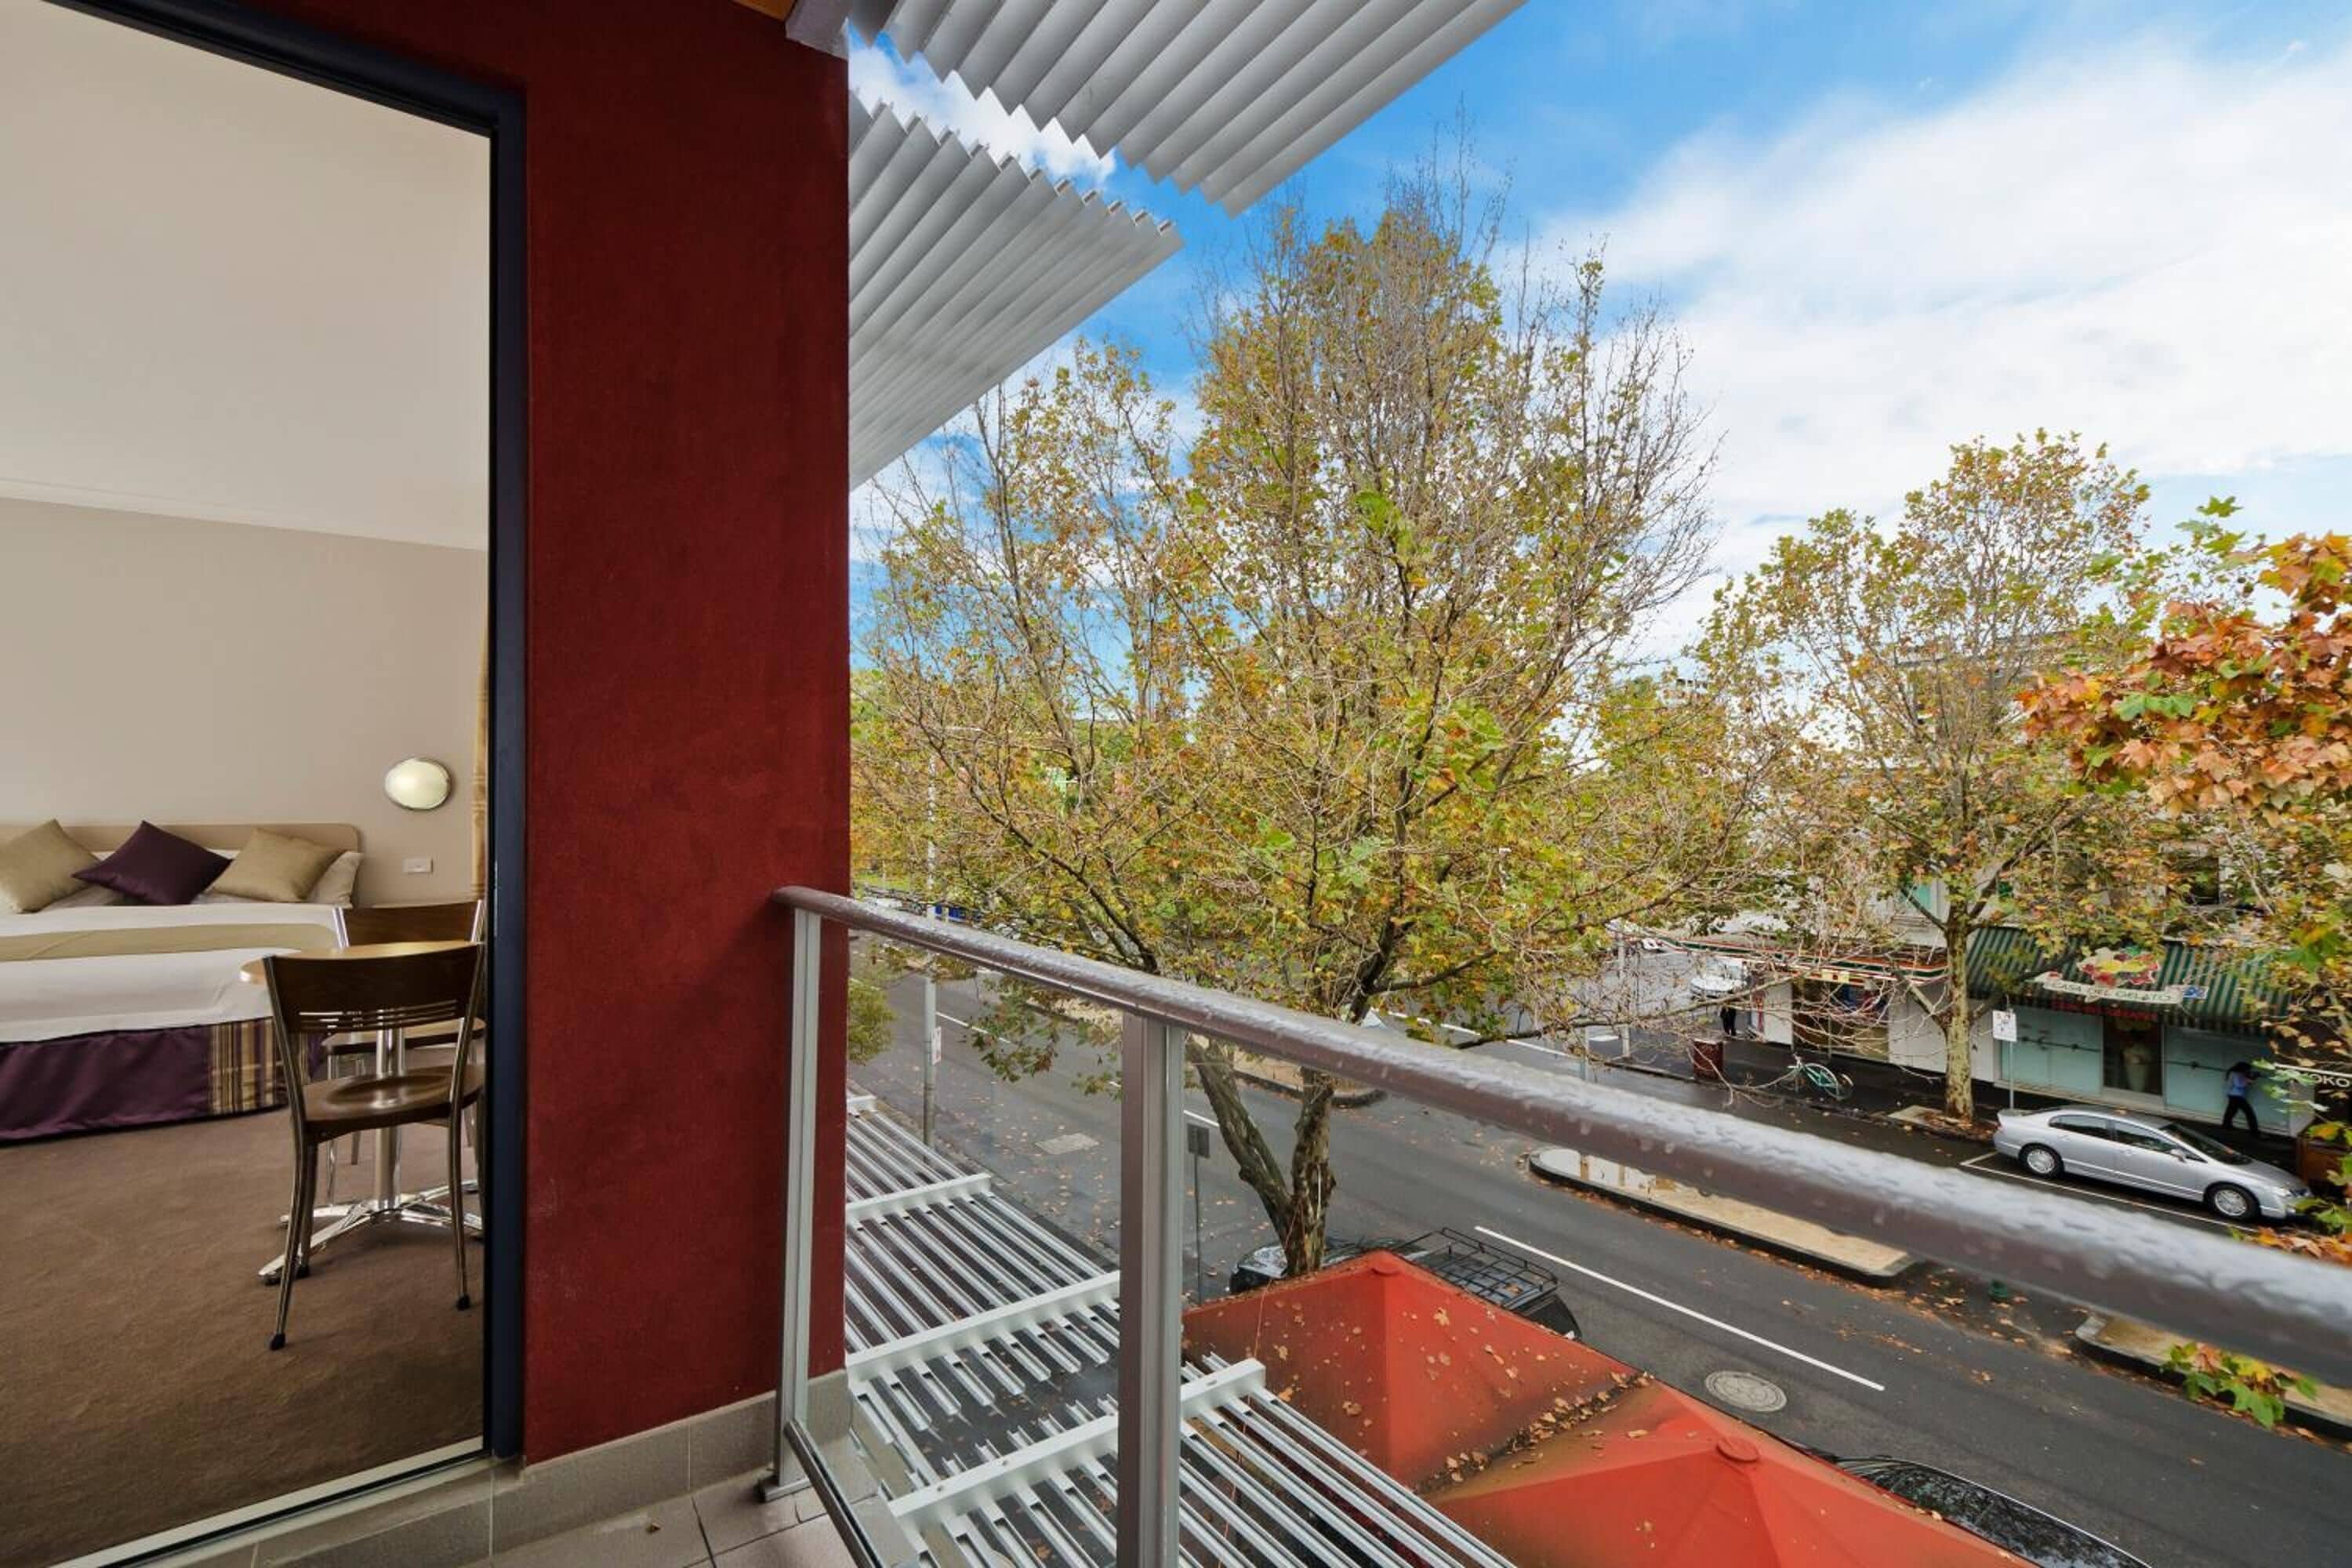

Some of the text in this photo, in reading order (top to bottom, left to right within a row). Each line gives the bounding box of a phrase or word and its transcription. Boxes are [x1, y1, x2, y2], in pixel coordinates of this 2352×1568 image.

[2052, 981, 2171, 1001] CASA DEL GELATO
